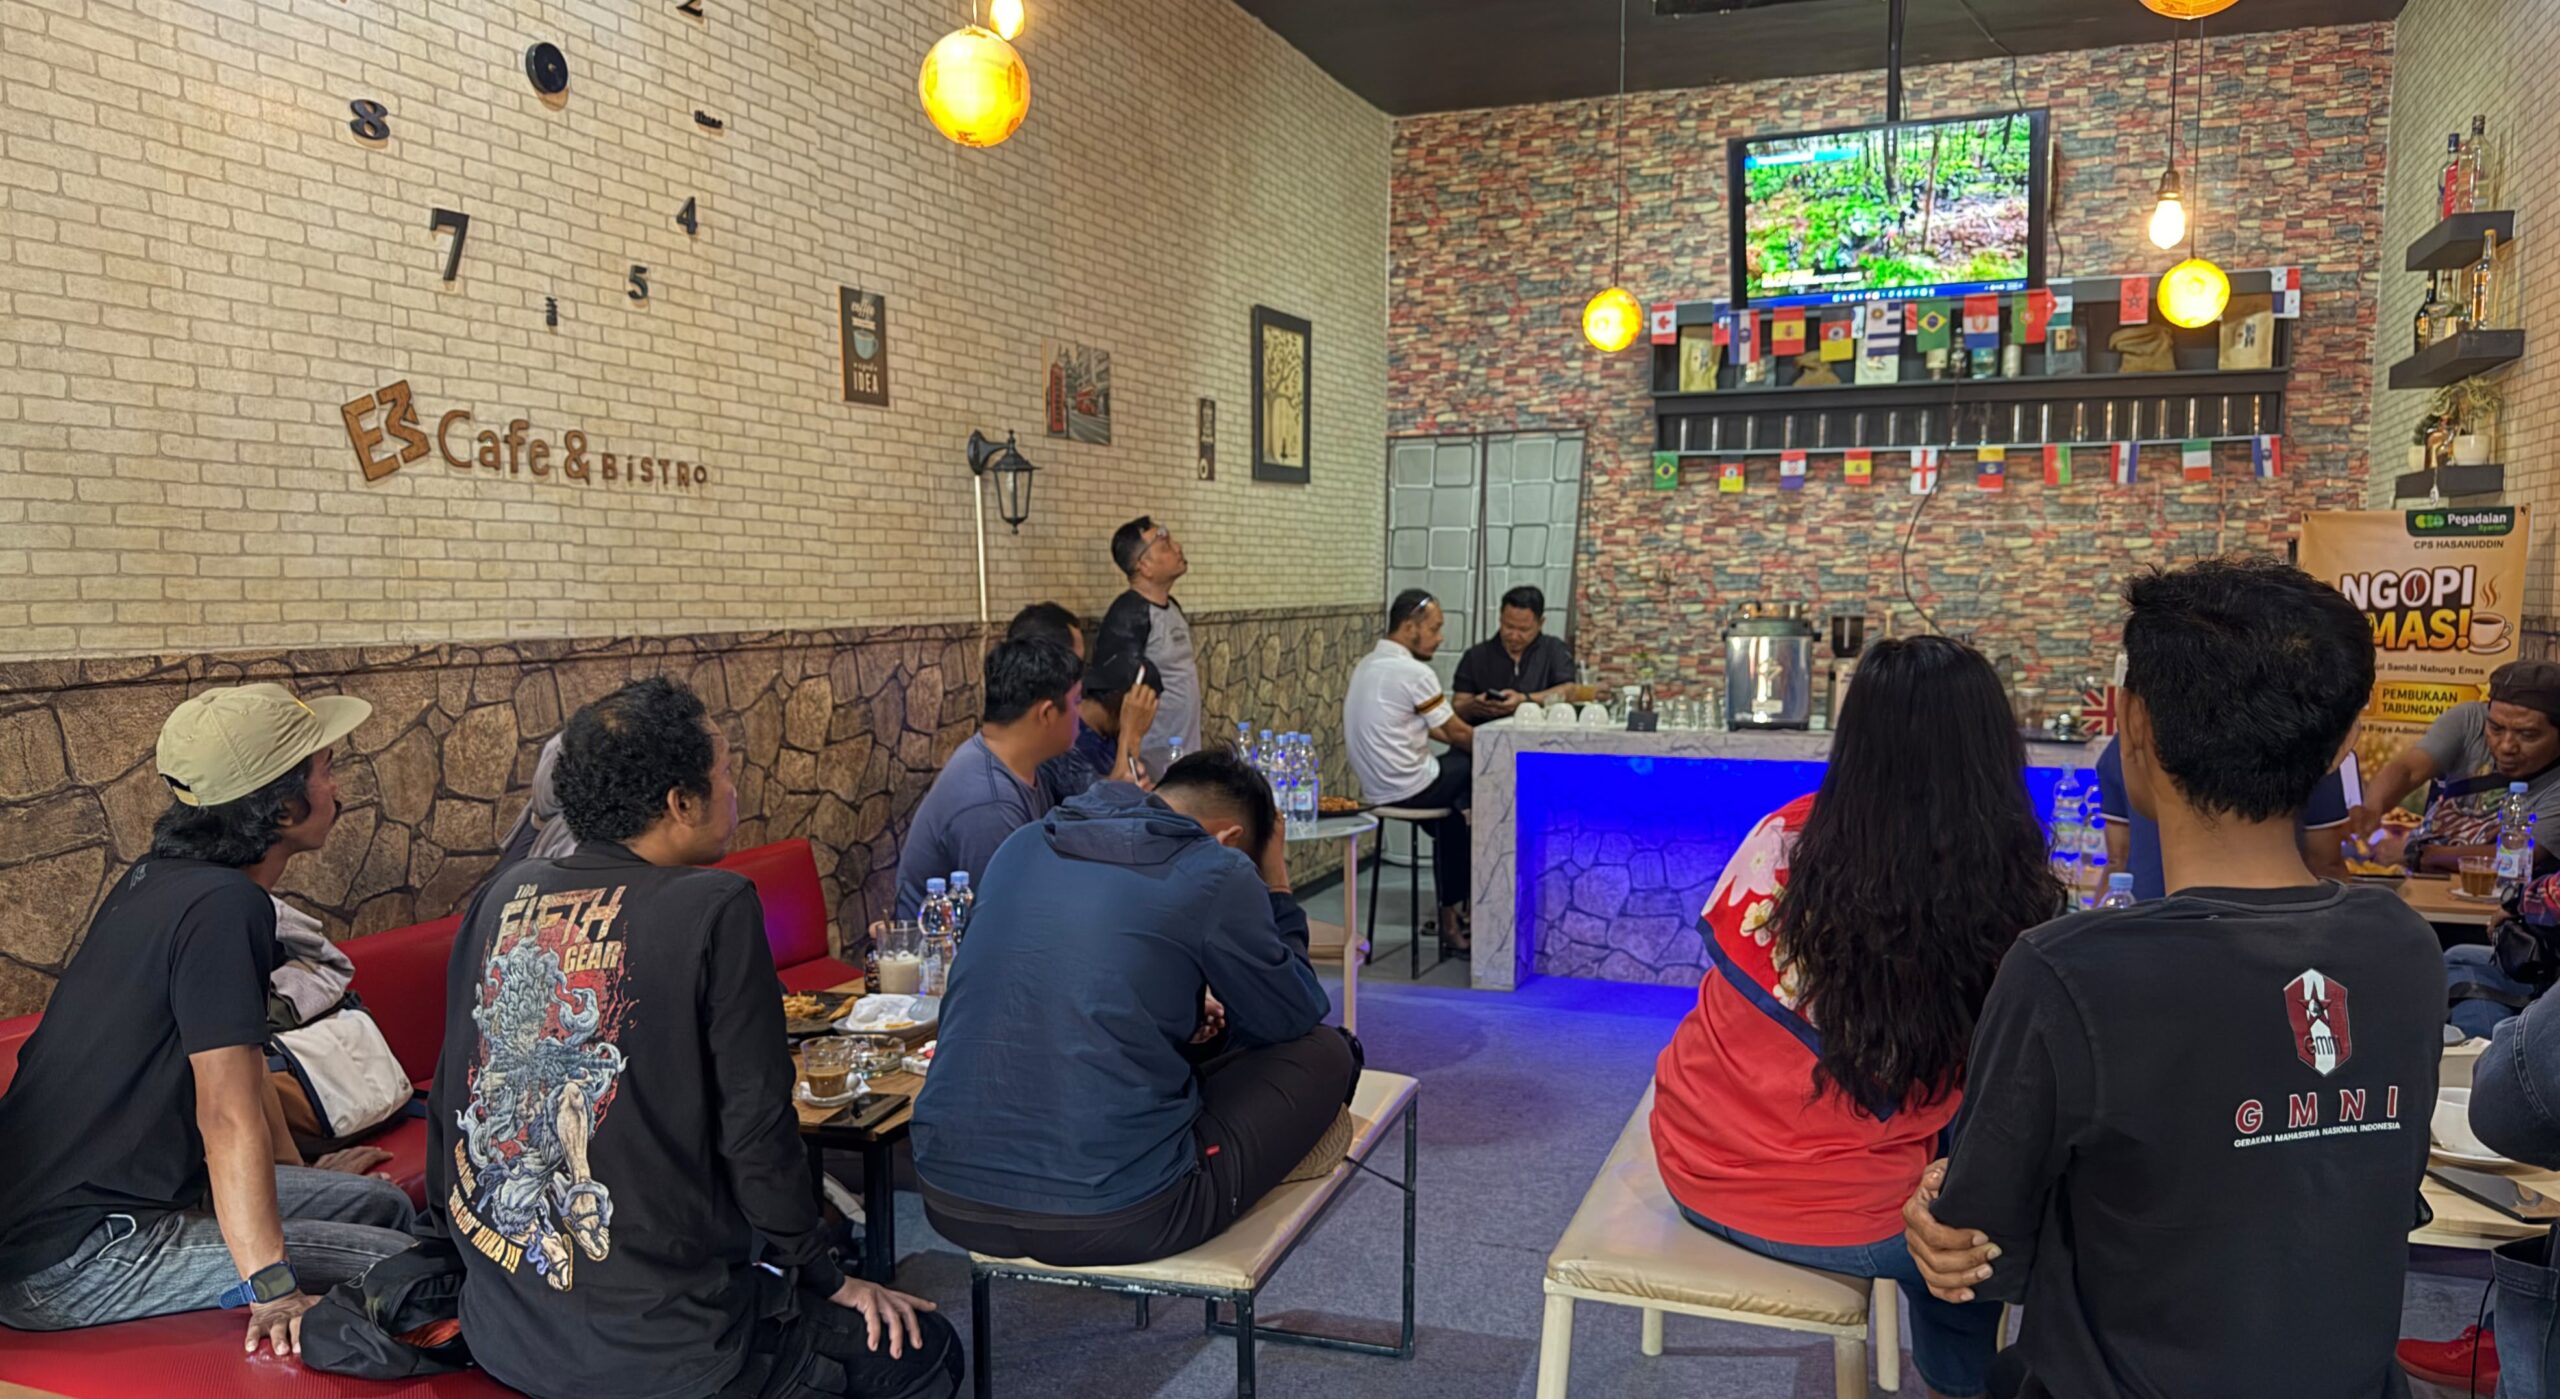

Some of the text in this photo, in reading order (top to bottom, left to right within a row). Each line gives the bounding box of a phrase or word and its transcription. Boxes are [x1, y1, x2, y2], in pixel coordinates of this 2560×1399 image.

[350, 99, 390, 140] 8
[676, 196, 698, 235] 4
[430, 208, 470, 281] 7
[627, 265, 649, 300] 5
[852, 370, 879, 395] IDEA
[438, 409, 550, 476] Cafe
[564, 429, 590, 486] &
[2447, 513, 2507, 527] Pegadaian
[2413, 540, 2504, 549] CPS HASANUDDIN
[2340, 565, 2476, 612] NGOPI
[2366, 608, 2472, 651] MAS!
[2387, 663, 2418, 671] Sambil
[2420, 664, 2456, 675] Nabung
[2458, 666, 2485, 675] Emas
[2382, 688, 2458, 703] PEMBUKAAN
[2382, 703, 2444, 715] TABUNGAN
[563, 941, 622, 974] GEAR
[2233, 1122, 2400, 1148] GERAKAN MAHASISWA NASIONAL INDONESIA
[471, 1225, 506, 1263] NIKA
